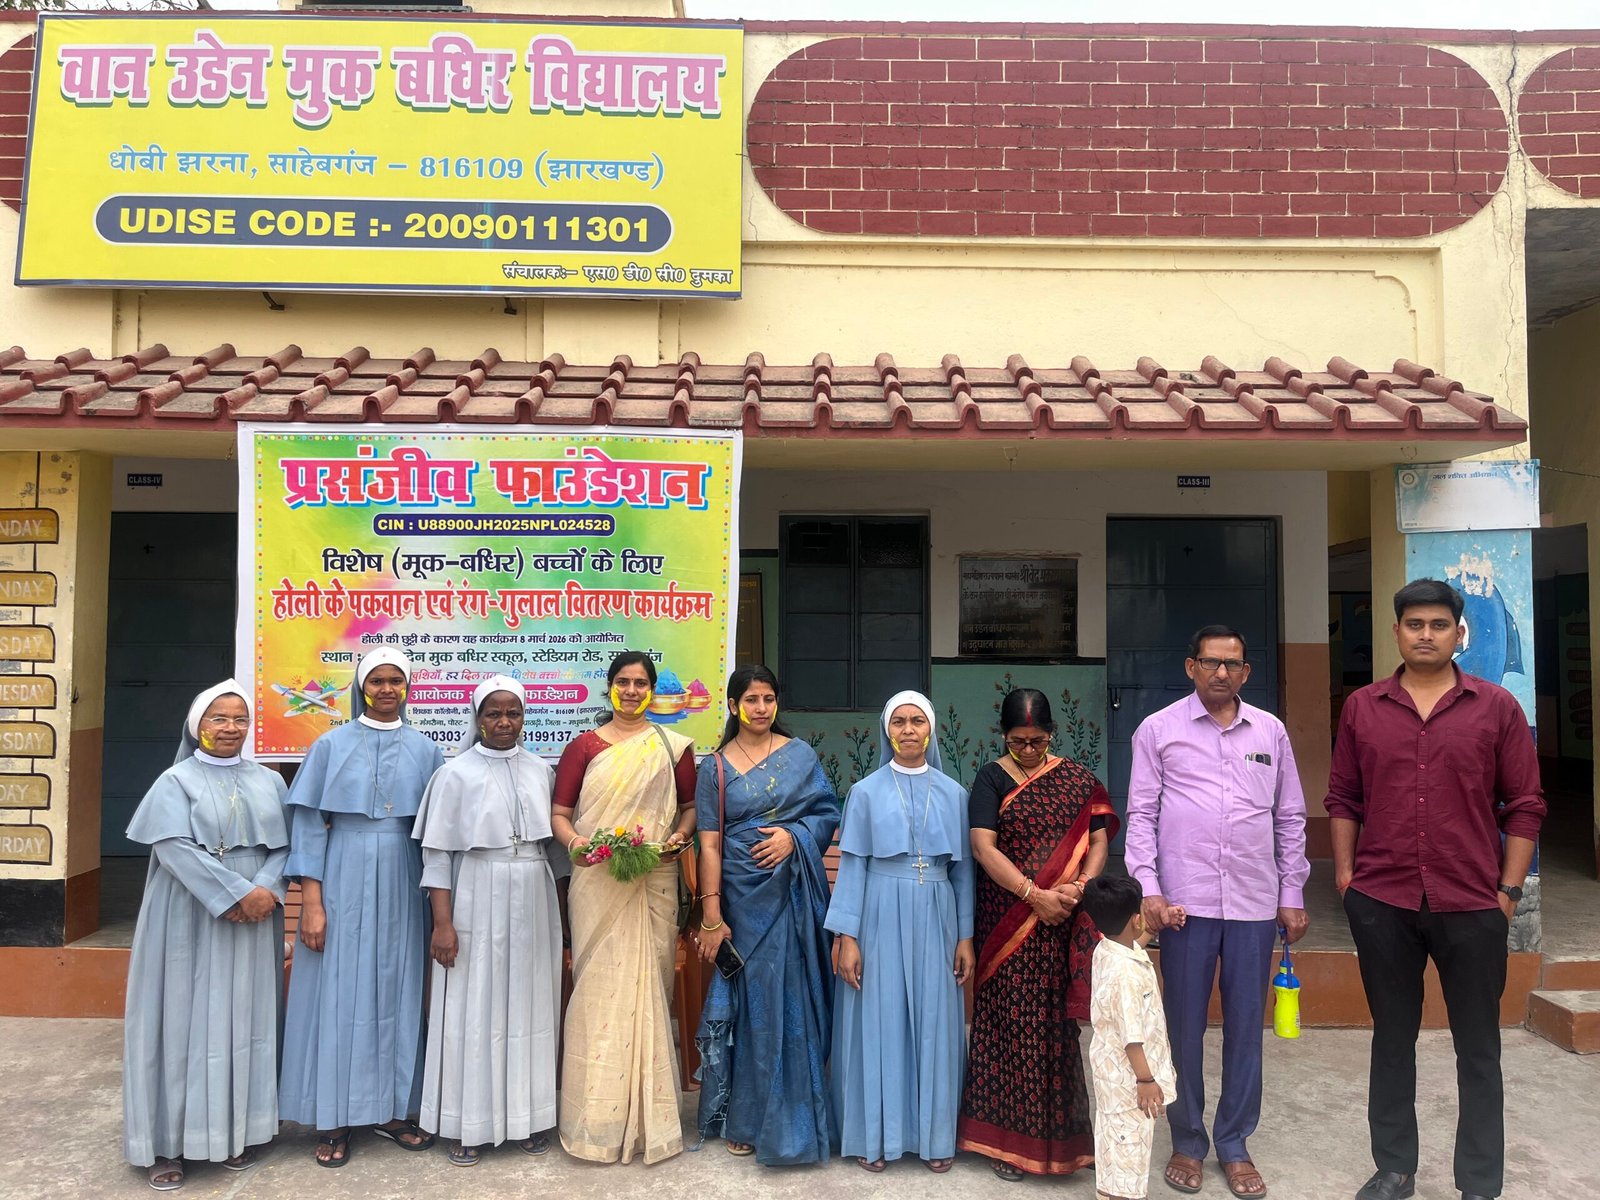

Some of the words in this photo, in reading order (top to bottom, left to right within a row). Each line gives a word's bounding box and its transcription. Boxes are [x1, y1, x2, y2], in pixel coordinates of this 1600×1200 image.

[58, 45, 155, 107] वान
[165, 28, 273, 108] उडेन
[282, 46, 382, 130] मुक
[390, 31, 516, 114] बधिर
[524, 33, 726, 119] विद्यालय
[109, 144, 167, 172] धोबी
[177, 152, 257, 179] झरना,
[268, 147, 377, 176] साहेबगंज
[420, 156, 523, 179] 816109
[534, 150, 666, 189] (झारखण्ड)
[119, 207, 236, 235] UDISE
[249, 209, 356, 237] CODE
[403, 212, 649, 243] 20090111301
[691, 268, 733, 287] दुमका
[128, 476, 162, 484] CLASS-IV
[279, 444, 479, 510] प्रसंजीव
[488, 446, 713, 511] फाउंडेशन
[1178, 478, 1210, 486] CLASS-III
[377, 519, 404, 531] CIN
[418, 519, 611, 531] U88900JH2025NPL024528
[322, 547, 384, 573] विशेष
[533, 546, 588, 573] बच्चों
[591, 549, 615, 573] के
[621, 548, 665, 575] लिए
[271, 577, 323, 620] होली
[324, 577, 346, 617] के
[347, 589, 422, 618] पकवान
[424, 578, 455, 618] एवं
[565, 579, 632, 618] वितरण
[634, 580, 715, 620] कार्यक्रम
[361, 633, 383, 644] होली
[385, 633, 399, 644] की
[420, 633, 431, 644] के
[433, 635, 460, 644] कारण
[462, 635, 477, 644] यह
[479, 632, 517, 644] कार्यक्रम
[520, 635, 525, 643] 8
[528, 632, 546, 643] मार्च
[548, 635, 566, 643] 2026
[569, 633, 582, 643] को
[584, 632, 624, 643] आयोजित
[321, 652, 353, 663] स्थान
[429, 652, 454, 666] मुक
[457, 648, 489, 663] बधिर
[491, 651, 528, 666] स्कूल,
[532, 648, 579, 663] स्टेडियम
[582, 648, 604, 663] रोड,
[446, 672, 459, 680] हर
[461, 669, 481, 681] दिल
[0, 684, 47, 702] ESDAY
[410, 687, 465, 700] आयोजक
[0, 732, 44, 750] SDAY
[0, 837, 45, 855] RDAY
